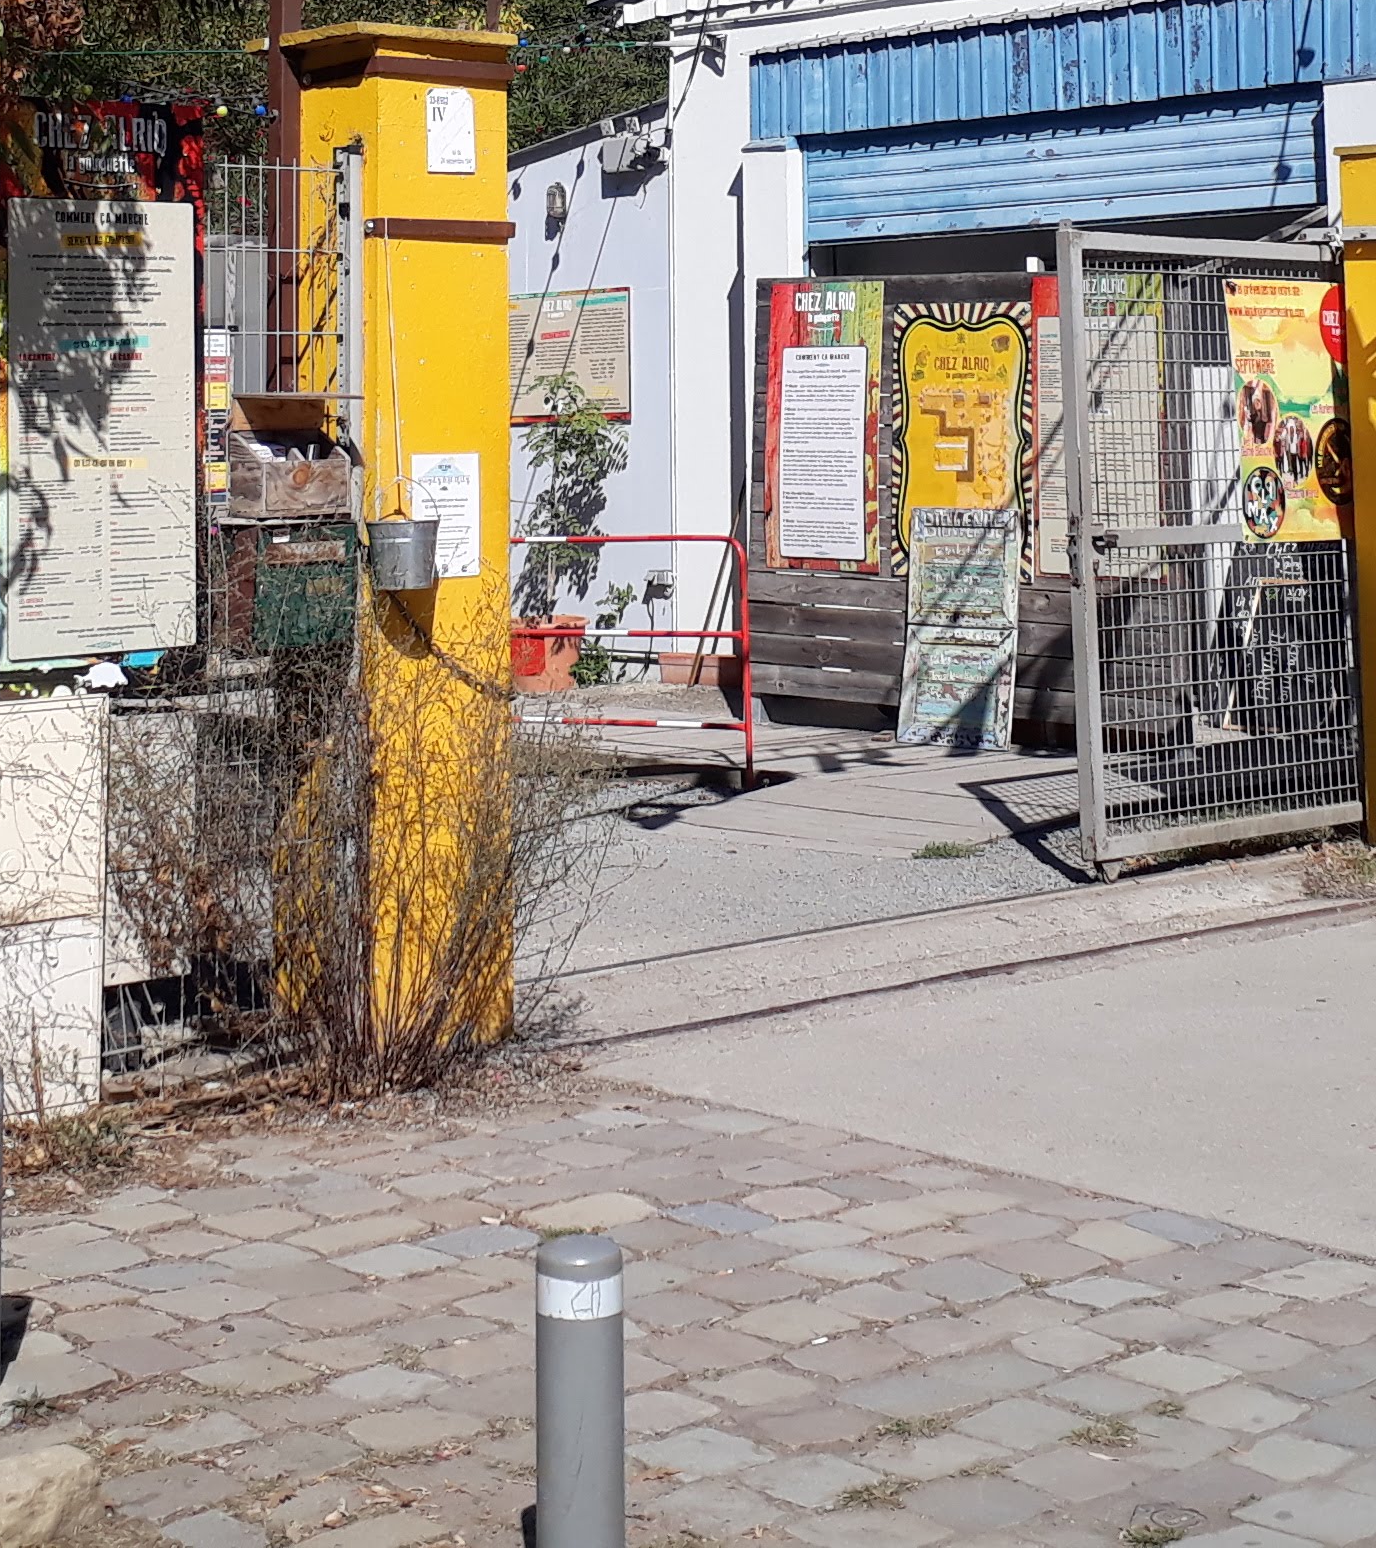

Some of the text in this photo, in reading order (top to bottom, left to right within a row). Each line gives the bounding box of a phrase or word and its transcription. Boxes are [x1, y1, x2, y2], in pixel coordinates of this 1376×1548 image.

[33, 110, 93, 150] CHEZ
[78, 155, 135, 174] guinguette
[55, 211, 150, 226] COMMENT ÇA MARCHE
[795, 291, 856, 312] CHEZ ALRIQ
[934, 356, 990, 372] CHEZ ALRIQ
[1235, 358, 1276, 375] SEPTEMBRE
